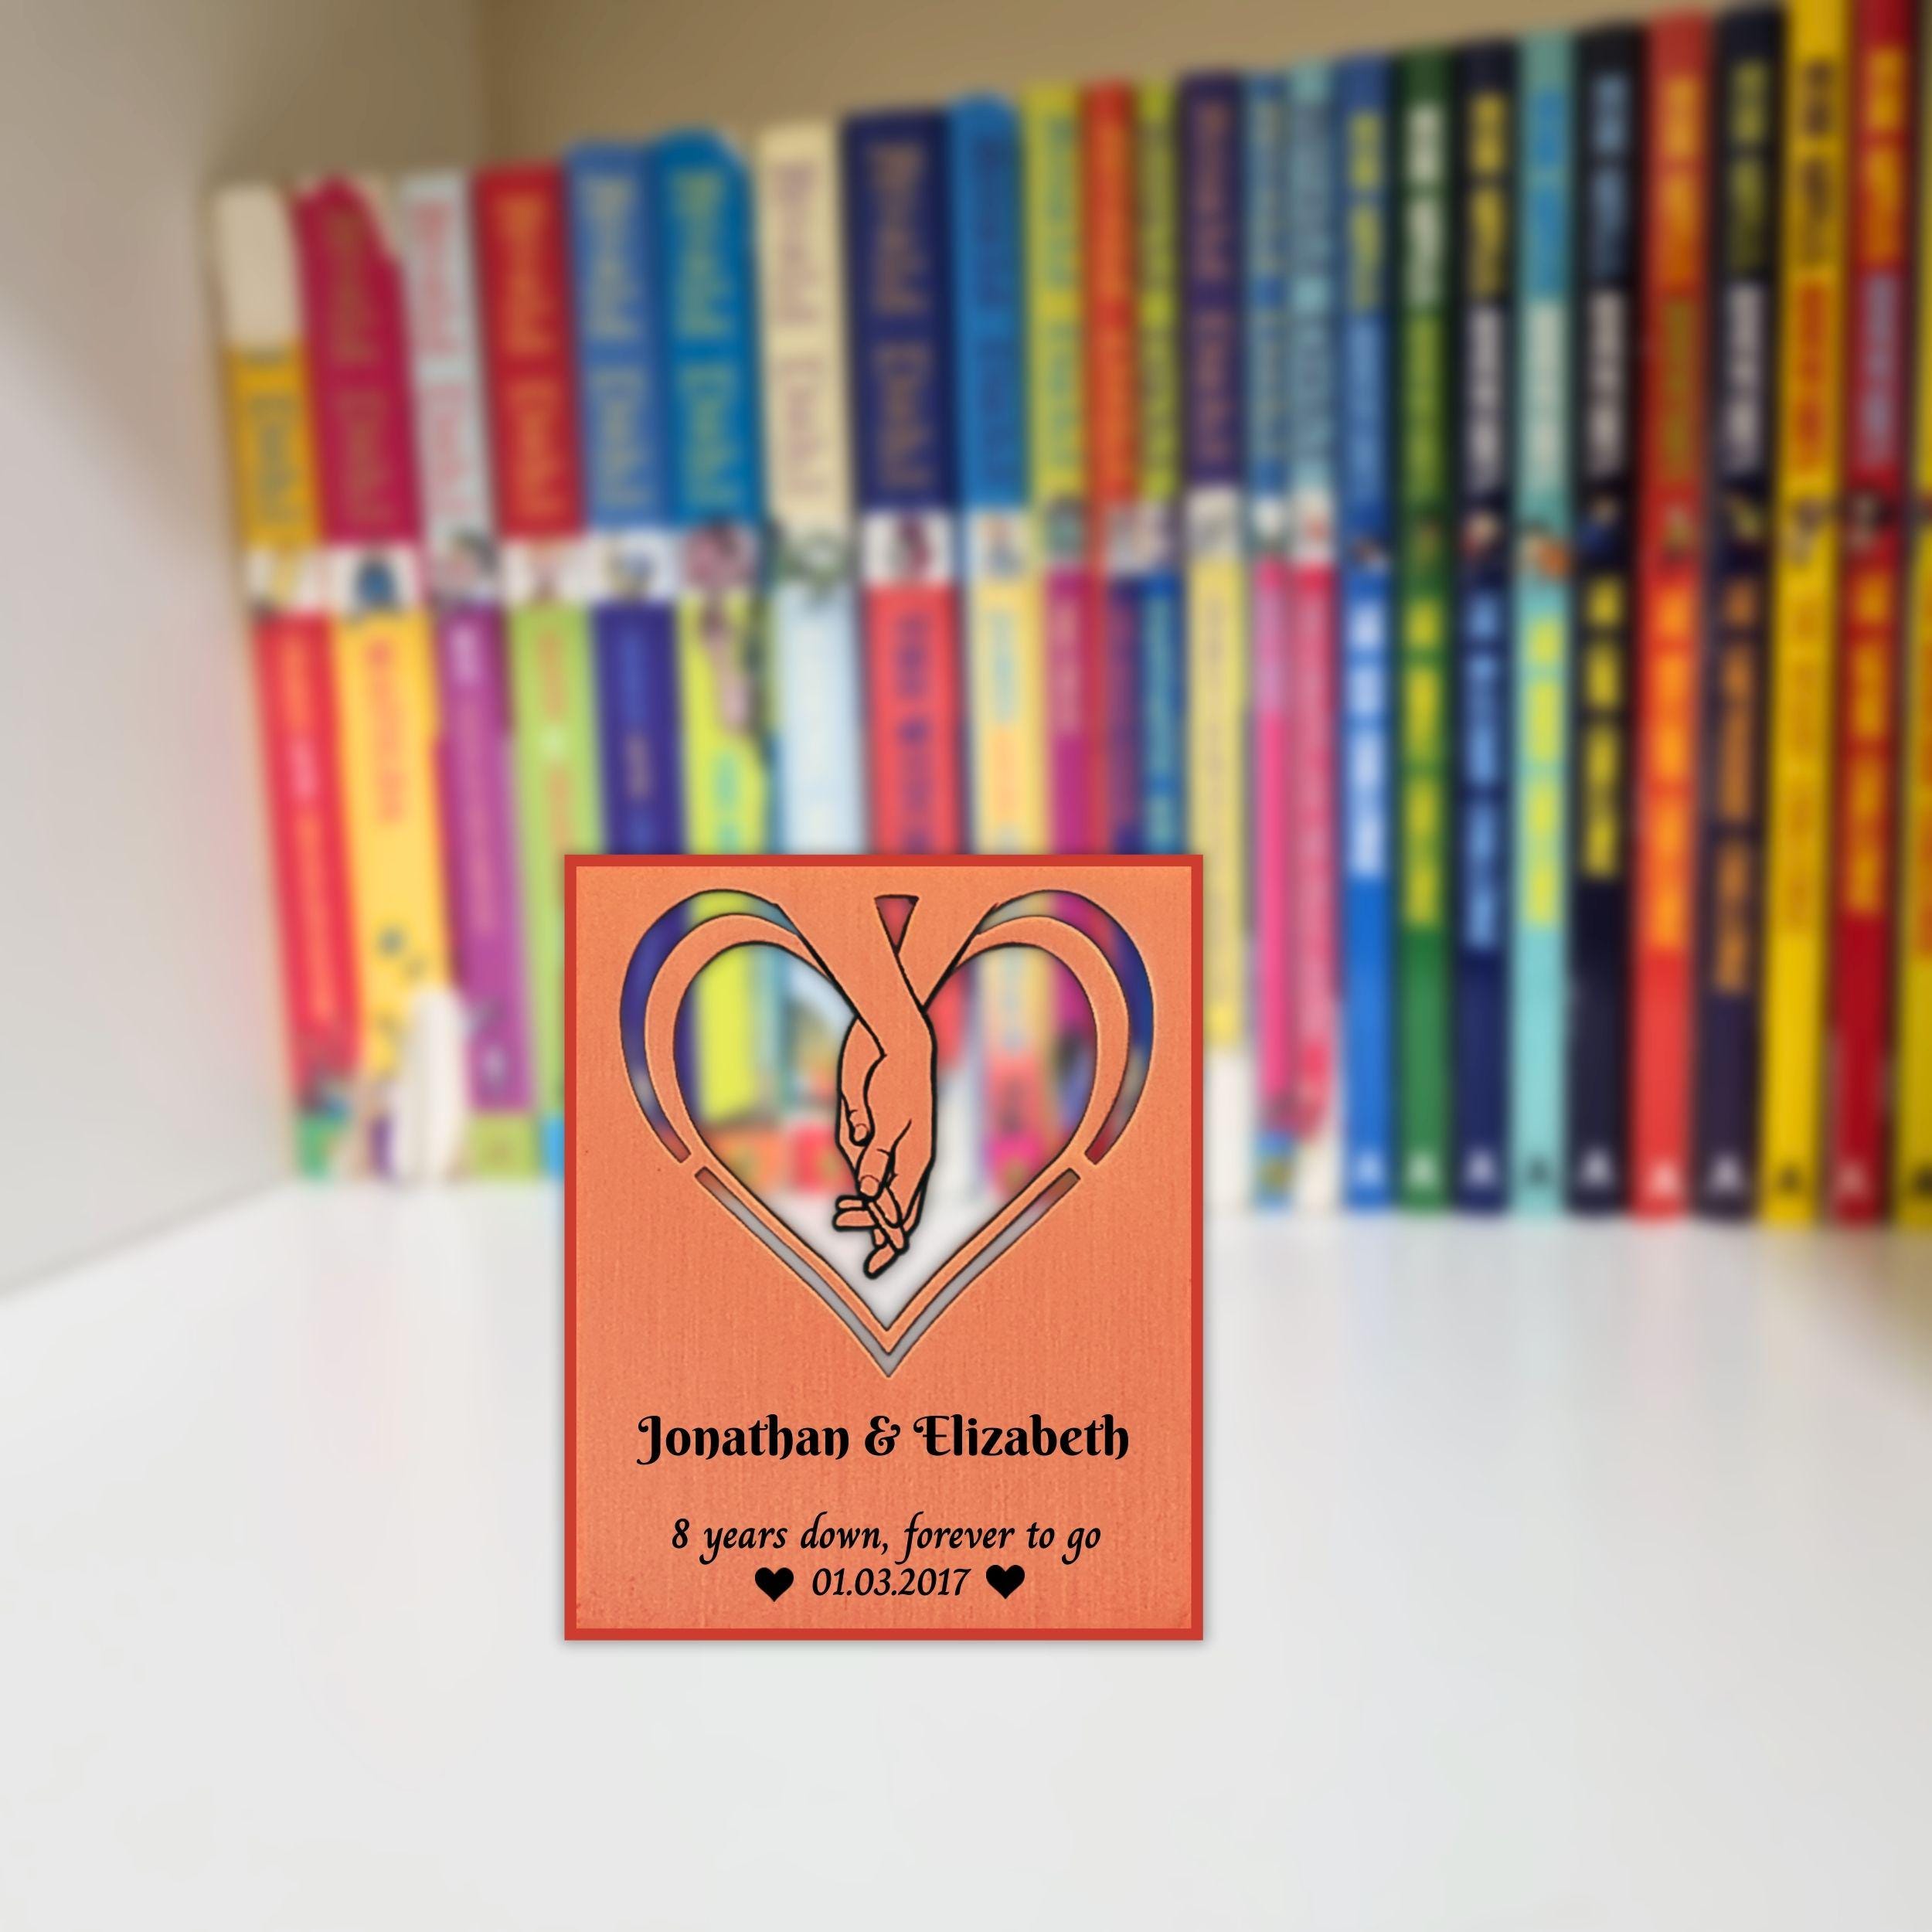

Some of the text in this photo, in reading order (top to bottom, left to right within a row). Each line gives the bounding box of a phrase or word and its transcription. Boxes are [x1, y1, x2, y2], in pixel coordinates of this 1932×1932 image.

[636, 1413, 1129, 1465] Jonathan & Elizabeth
[672, 1511, 1101, 1566] 8 years down, forever to go
[812, 1567, 971, 1596] 01.03.2017
